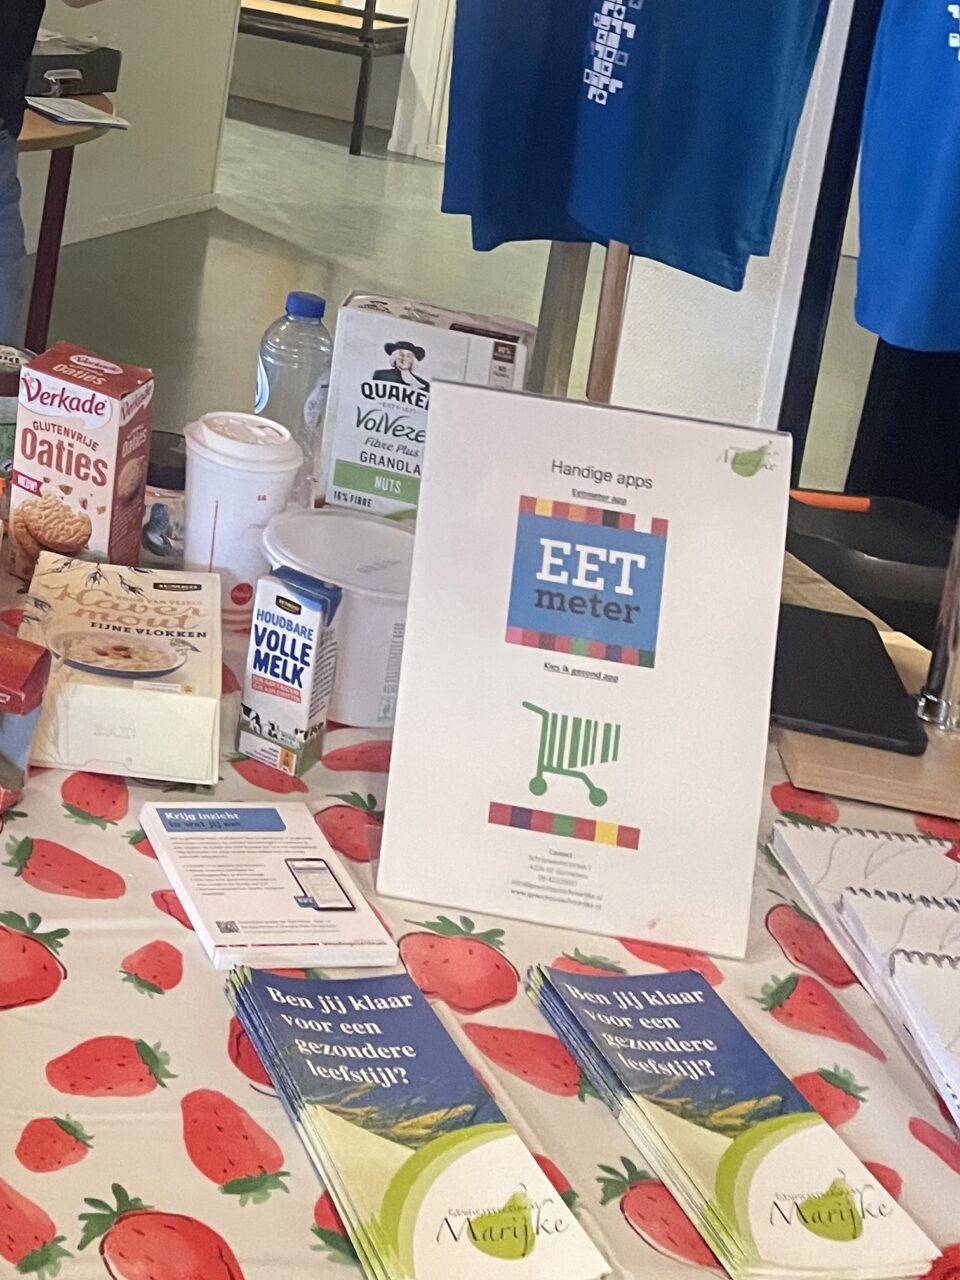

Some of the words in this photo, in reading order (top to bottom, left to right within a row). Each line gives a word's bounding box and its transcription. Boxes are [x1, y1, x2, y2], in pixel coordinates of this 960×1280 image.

[21, 376, 106, 417] Verkade
[33, 420, 100, 452] GLUTENVRIJE
[356, 406, 426, 444] VolVeze
[21, 427, 109, 487] Oaties
[364, 437, 394, 453] Fibre
[396, 443, 420, 458] Plus
[359, 451, 422, 476] GRANOLA
[551, 458, 613, 485] Handige
[617, 473, 653, 491] apps
[374, 475, 402, 494] NUTS
[350, 493, 372, 508] FIBRE
[536, 538, 646, 596] EET
[534, 587, 641, 625] meter
[90, 621, 131, 634] FIJNE
[135, 629, 208, 639] VLOKKEN
[256, 608, 314, 641] HOUDBARE
[254, 623, 313, 667] VOLLE
[253, 648, 305, 689] MELK
[544, 661, 560, 672] Kies
[165, 812, 195, 822] Krijg
[198, 811, 240, 821] inzicht
[265, 985, 315, 1009] Ben
[318, 994, 347, 1015] jij
[348, 994, 414, 1012] klaar
[565, 983, 611, 1006] Ben
[612, 990, 644, 1011] jij
[641, 990, 705, 1007] klaar
[281, 1013, 334, 1034] voor
[340, 1021, 383, 1035] een
[584, 1008, 634, 1029] voor
[639, 1016, 681, 1030] een
[294, 1038, 417, 1059] gezondere
[602, 1032, 718, 1053] gezondere
[306, 1059, 409, 1088] leefstijl?
[617, 1052, 716, 1081] leefstijl?
[769, 1184, 892, 1240] Marijke
[436, 1198, 569, 1257] Marijke
